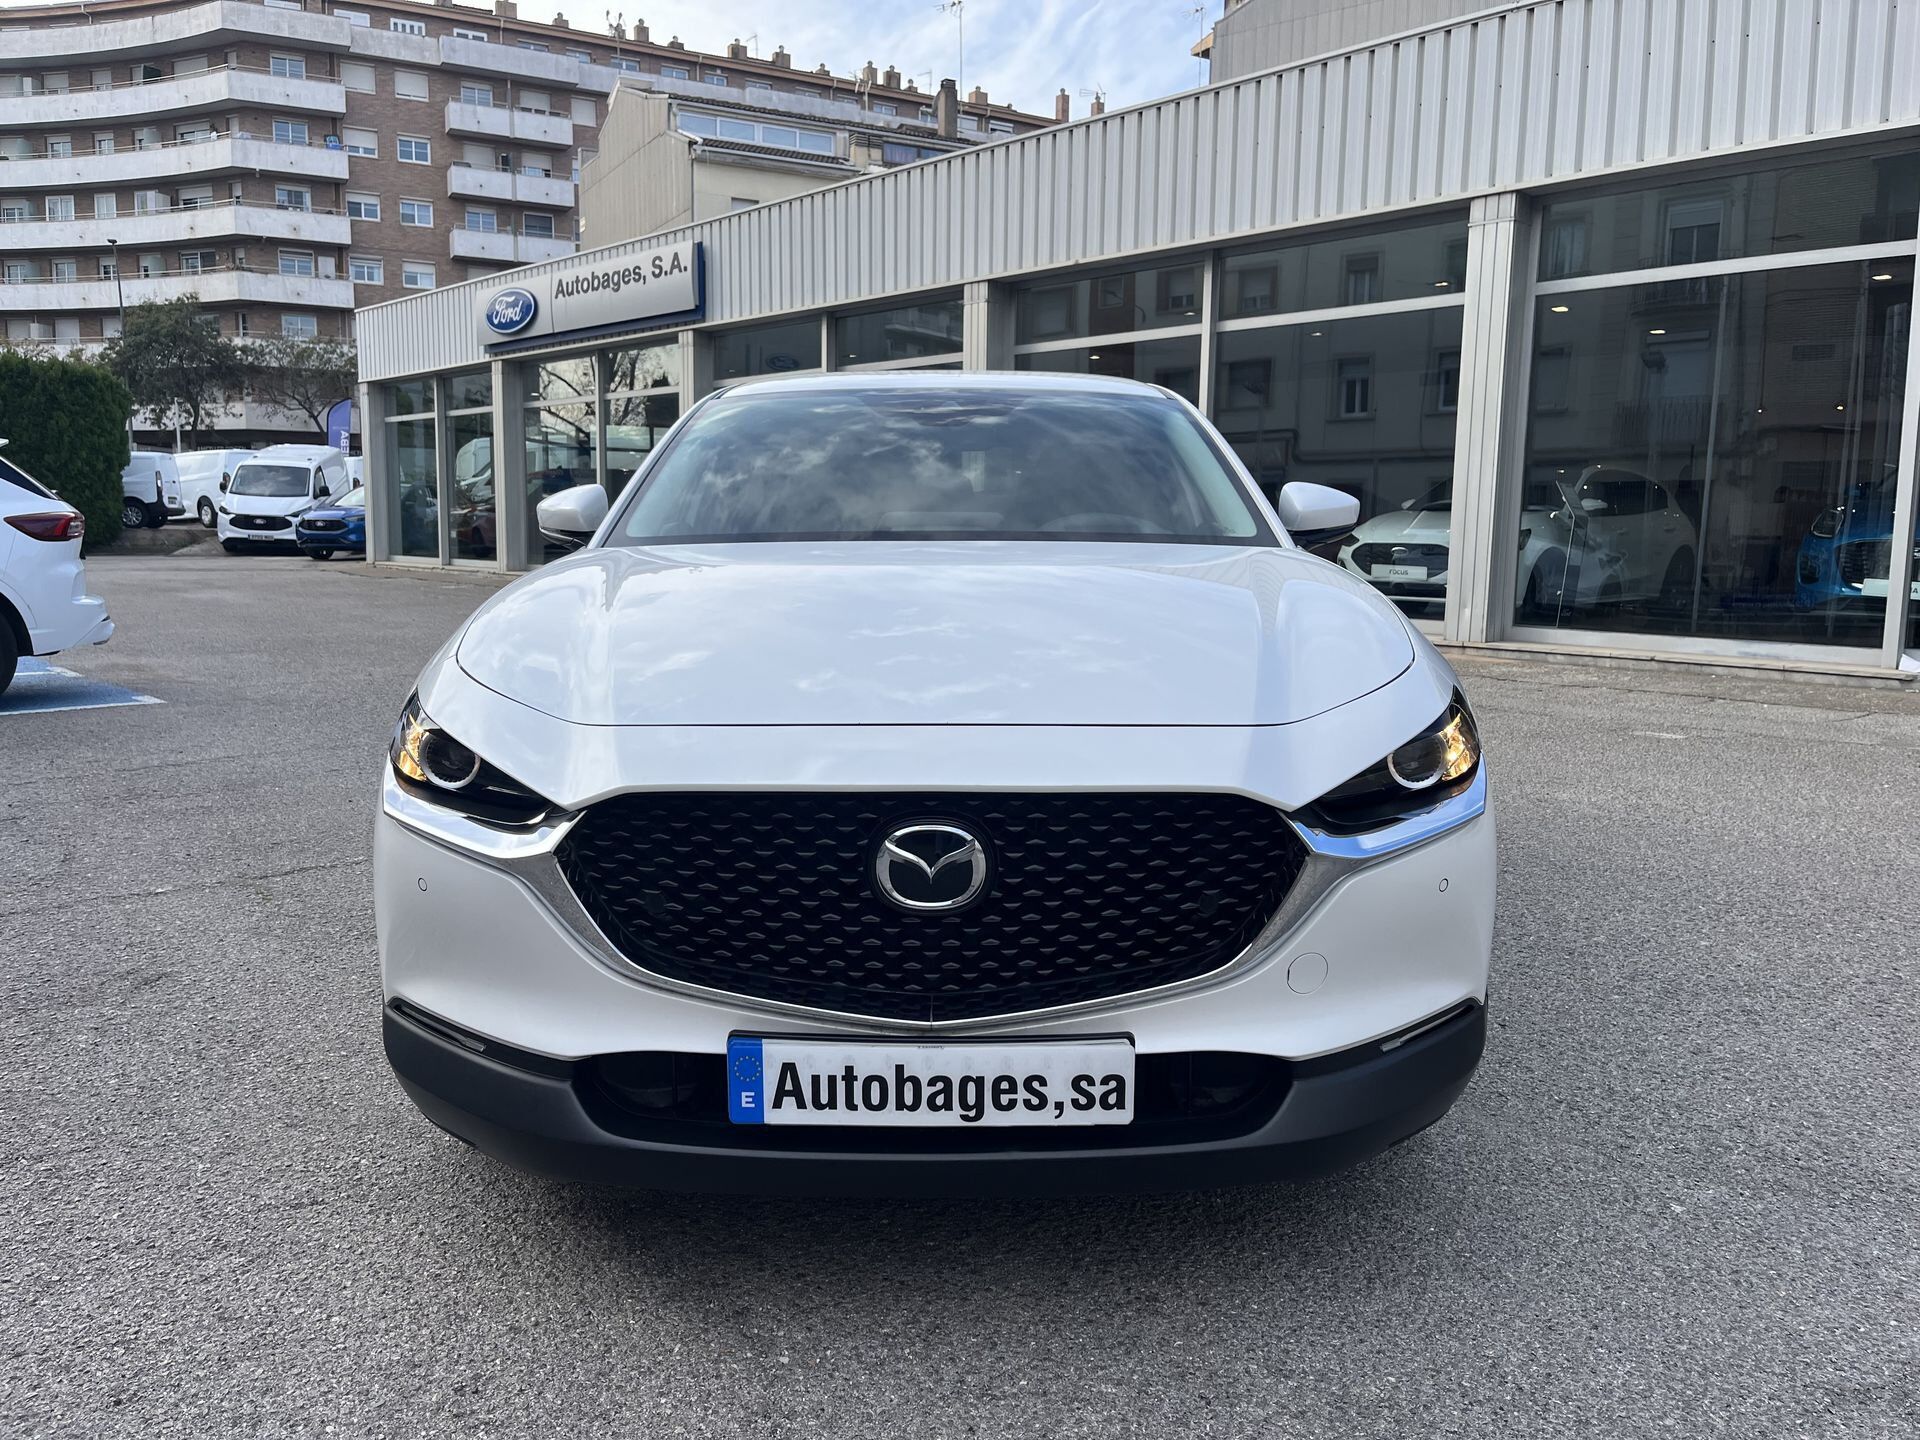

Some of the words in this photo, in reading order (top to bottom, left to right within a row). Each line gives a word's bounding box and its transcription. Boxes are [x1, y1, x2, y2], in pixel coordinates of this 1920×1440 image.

[554, 265, 646, 299] Autobages,
[651, 251, 688, 278] S.A.
[492, 296, 523, 325] Ford
[741, 1091, 756, 1108] E
[771, 1061, 1127, 1122] Autobages,sa
